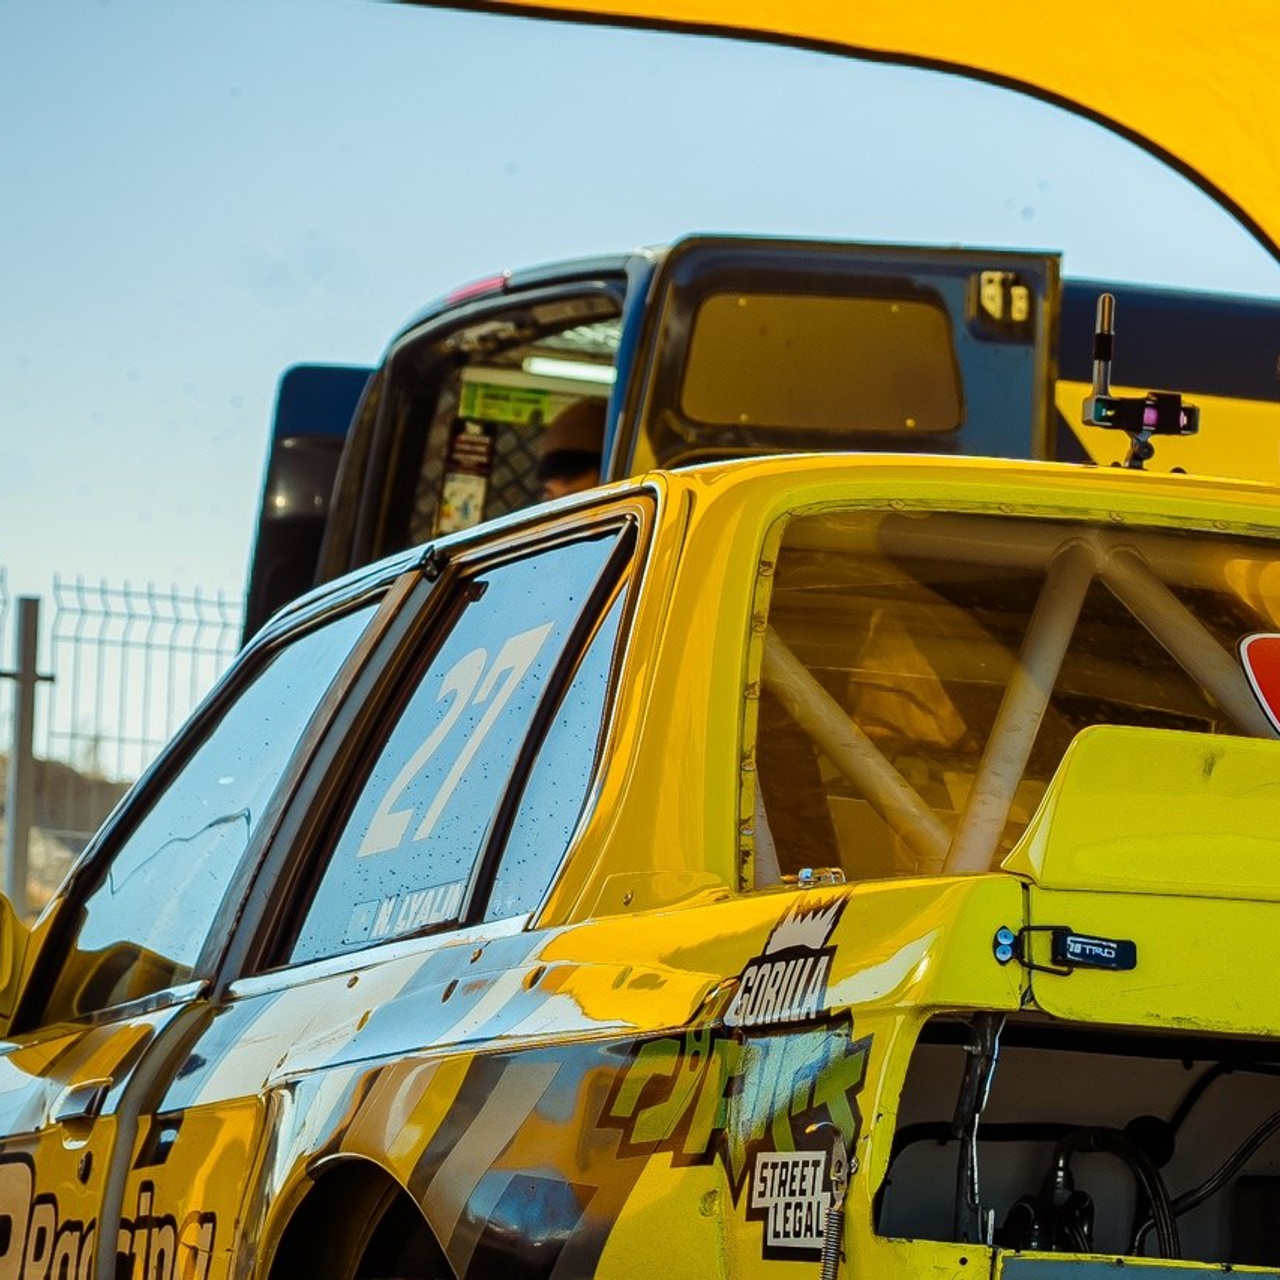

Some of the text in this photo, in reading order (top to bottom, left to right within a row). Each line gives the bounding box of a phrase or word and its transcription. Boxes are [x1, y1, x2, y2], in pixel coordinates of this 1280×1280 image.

[356, 621, 555, 858] 27
[723, 955, 830, 1027] GORILLA
[757, 1161, 821, 1198] STREET
[771, 1201, 824, 1239] LEGAL
